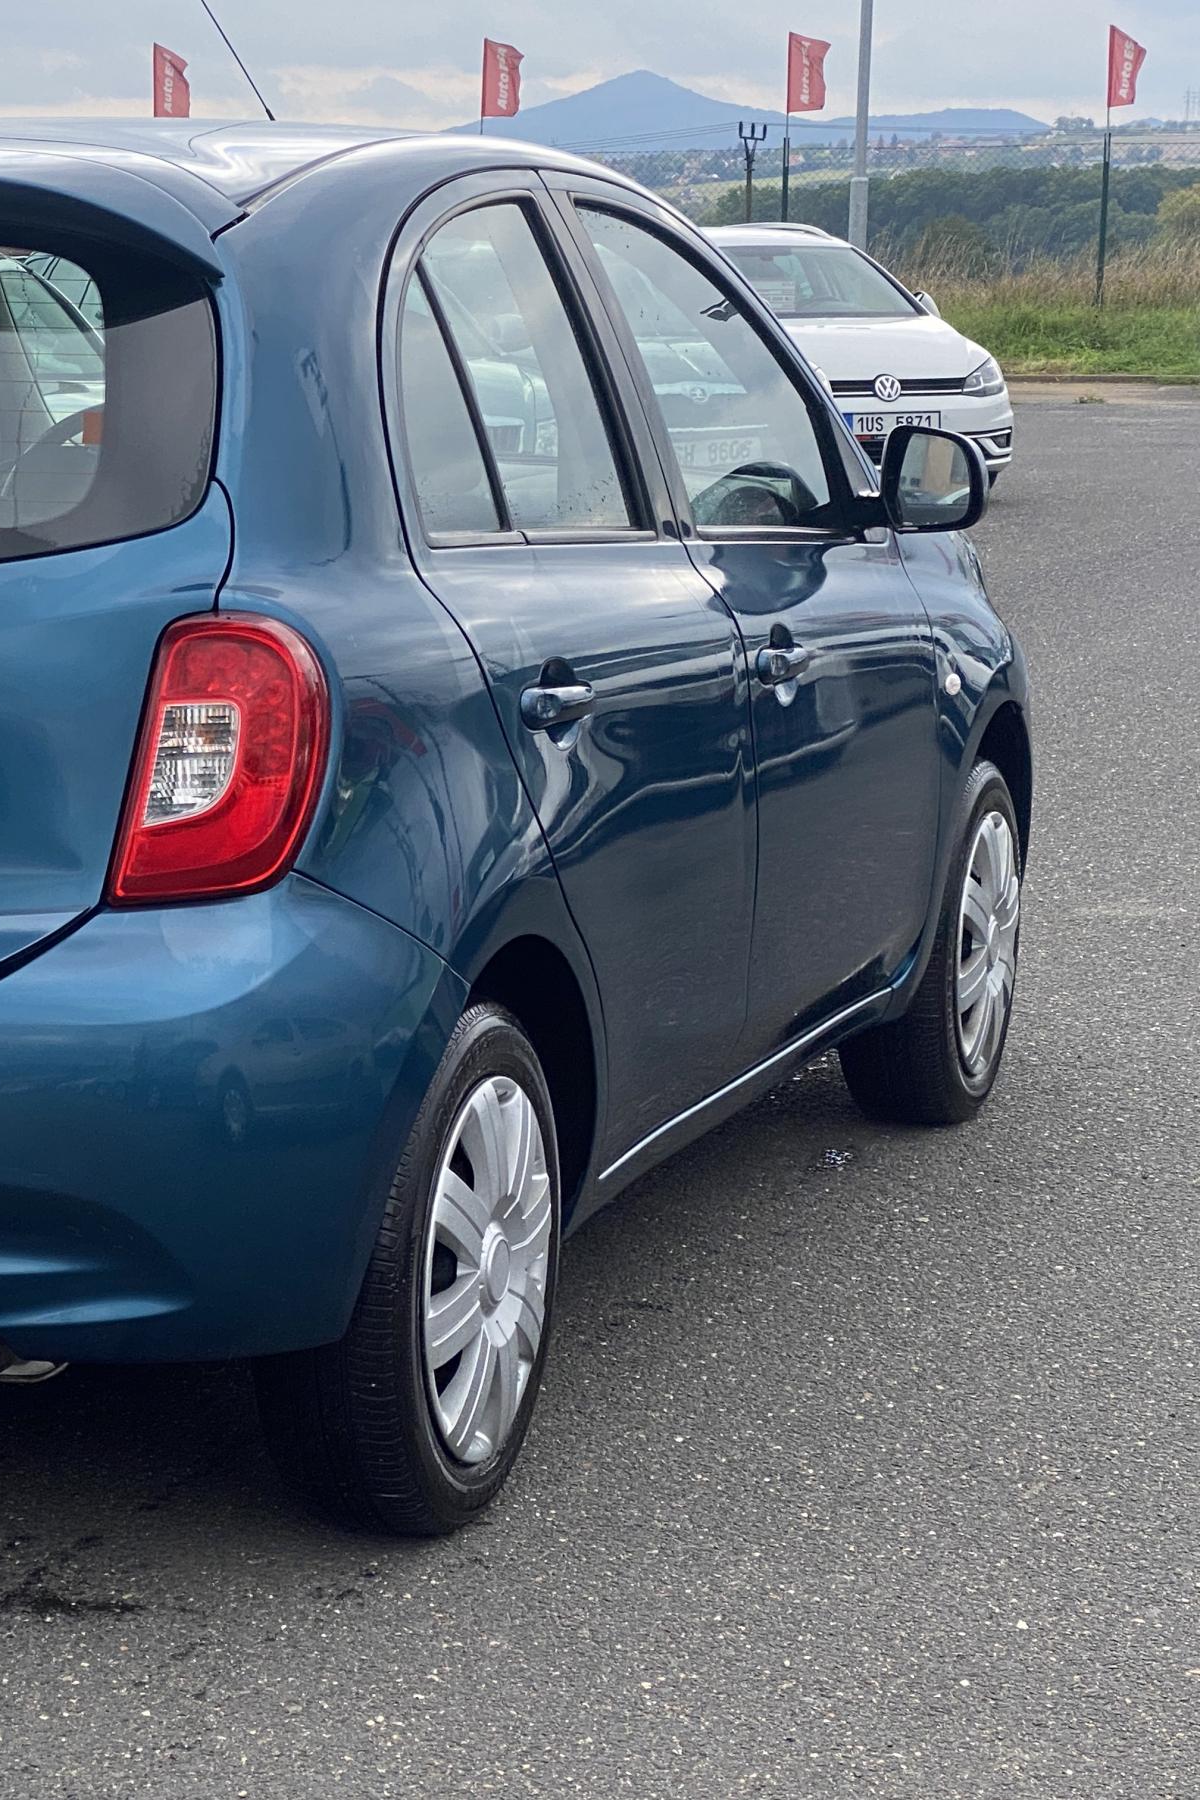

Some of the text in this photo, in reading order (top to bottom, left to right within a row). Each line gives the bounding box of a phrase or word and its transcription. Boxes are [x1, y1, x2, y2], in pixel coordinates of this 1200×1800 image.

[163, 79, 174, 114] Auto
[497, 72, 509, 111] Auto
[800, 66, 810, 105] Auto
[1119, 60, 1133, 99] Auto
[857, 416, 884, 432] 1US
